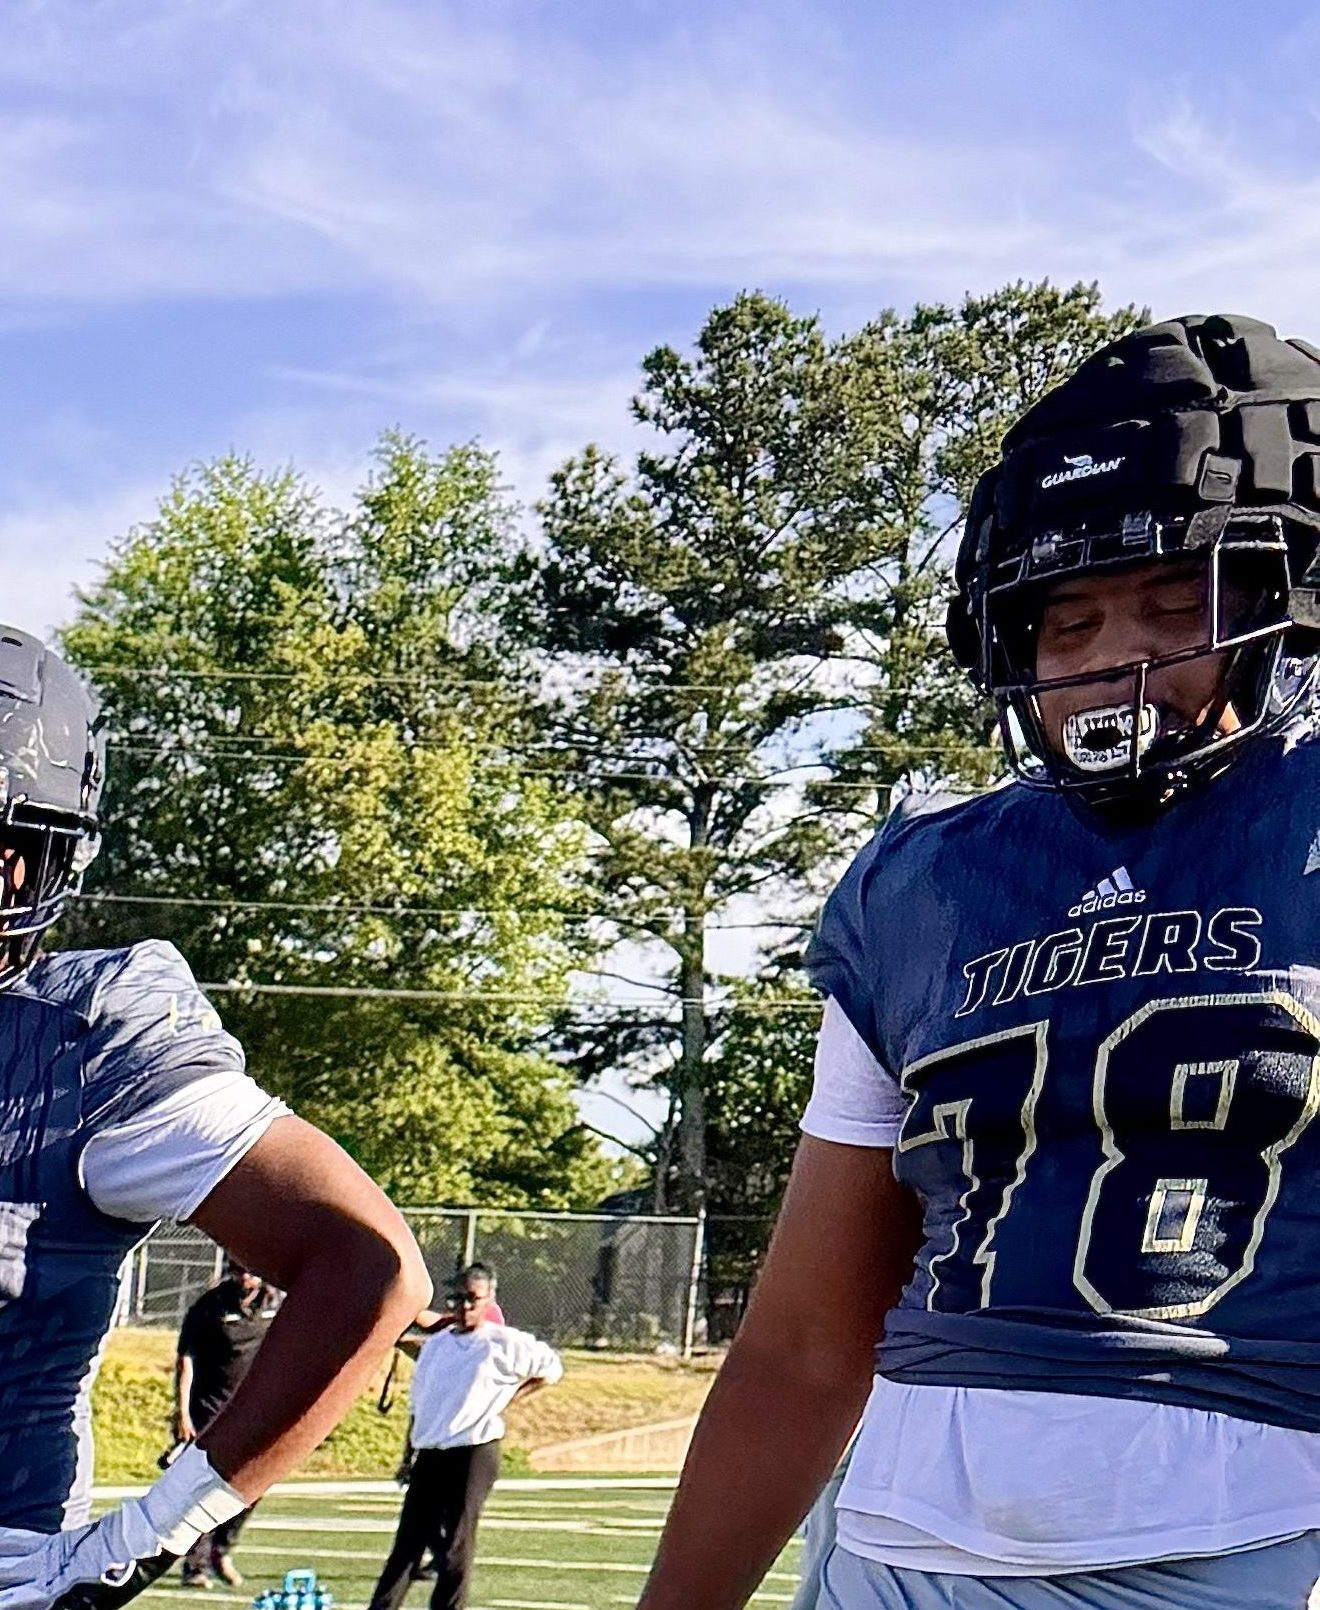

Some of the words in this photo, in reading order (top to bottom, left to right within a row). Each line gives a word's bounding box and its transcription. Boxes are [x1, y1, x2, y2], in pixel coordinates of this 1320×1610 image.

[1041, 457, 1122, 489] GUARDIAN
[1068, 888, 1147, 918] adidas
[954, 907, 1264, 1019] TIGERS
[898, 990, 1320, 1318] 78
